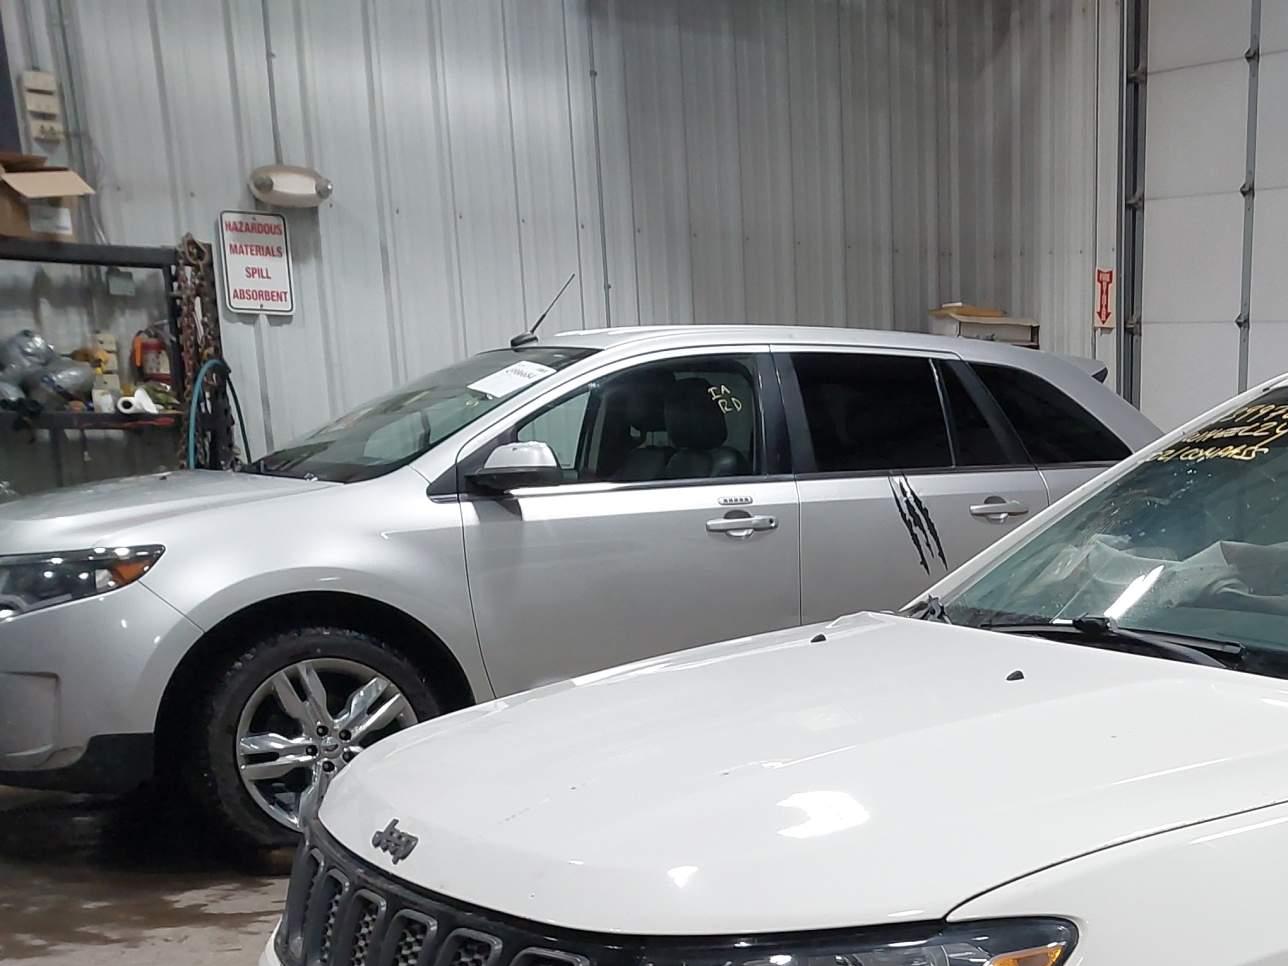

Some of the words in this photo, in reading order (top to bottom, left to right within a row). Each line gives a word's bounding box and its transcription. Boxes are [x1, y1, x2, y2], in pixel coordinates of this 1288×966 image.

[225, 221, 283, 236] HAZARDOUS
[229, 243, 283, 258] MATERIALS
[245, 266, 272, 280] SPILL
[232, 288, 289, 303] ABSORBENT
